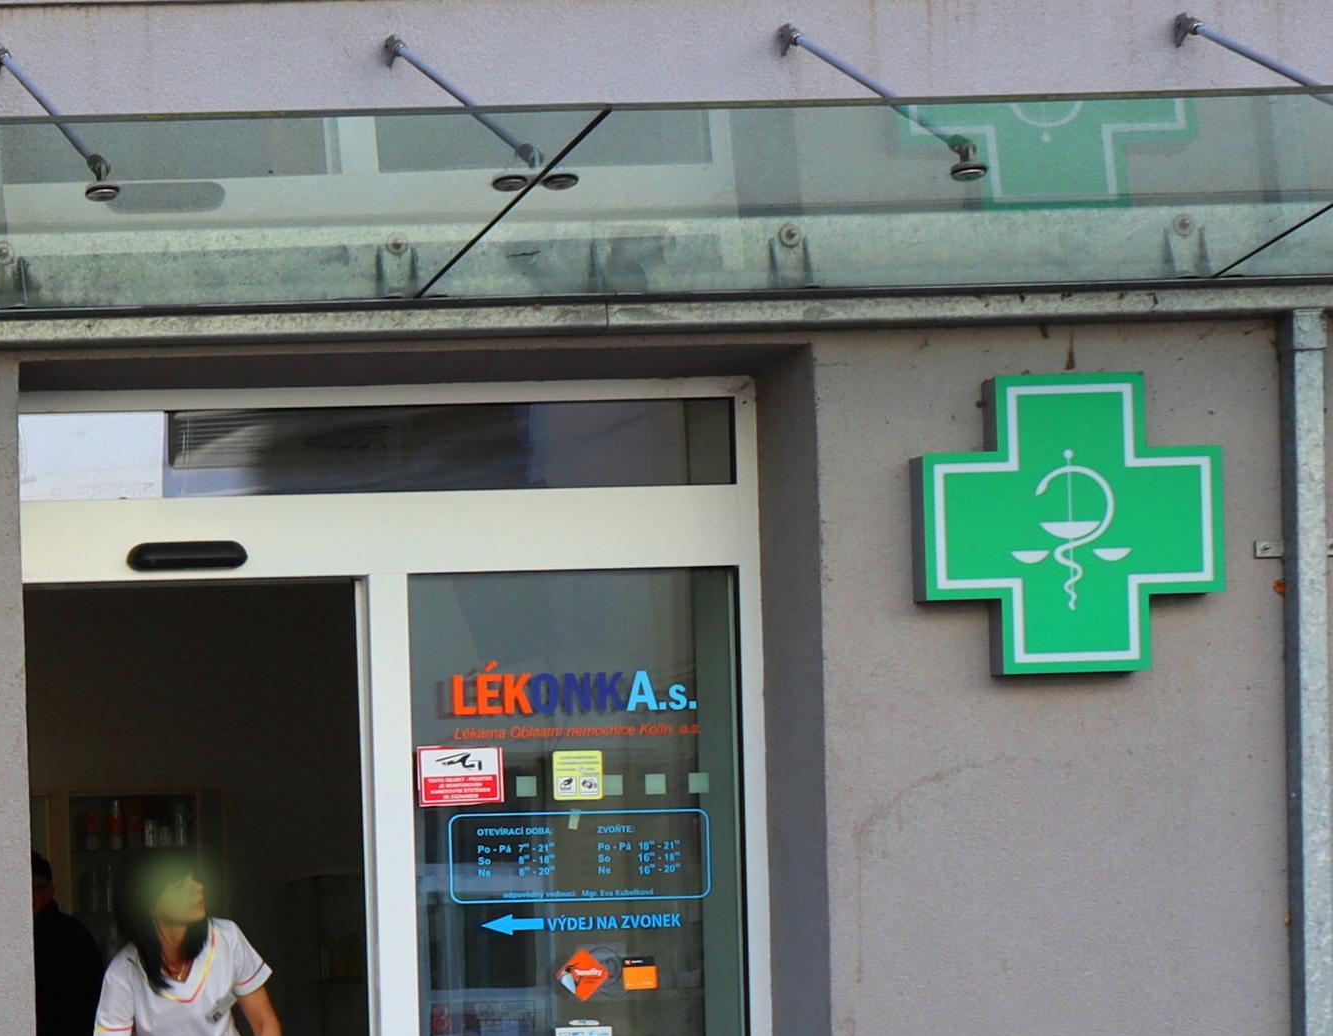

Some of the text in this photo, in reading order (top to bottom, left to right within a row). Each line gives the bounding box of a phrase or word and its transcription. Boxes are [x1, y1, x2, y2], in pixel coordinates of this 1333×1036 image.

[477, 826, 524, 837] OTEVÍRACÍ
[478, 857, 491, 866] So
[597, 854, 611, 863] So
[548, 913, 681, 932] VÝDEJ NA ZVONEK
